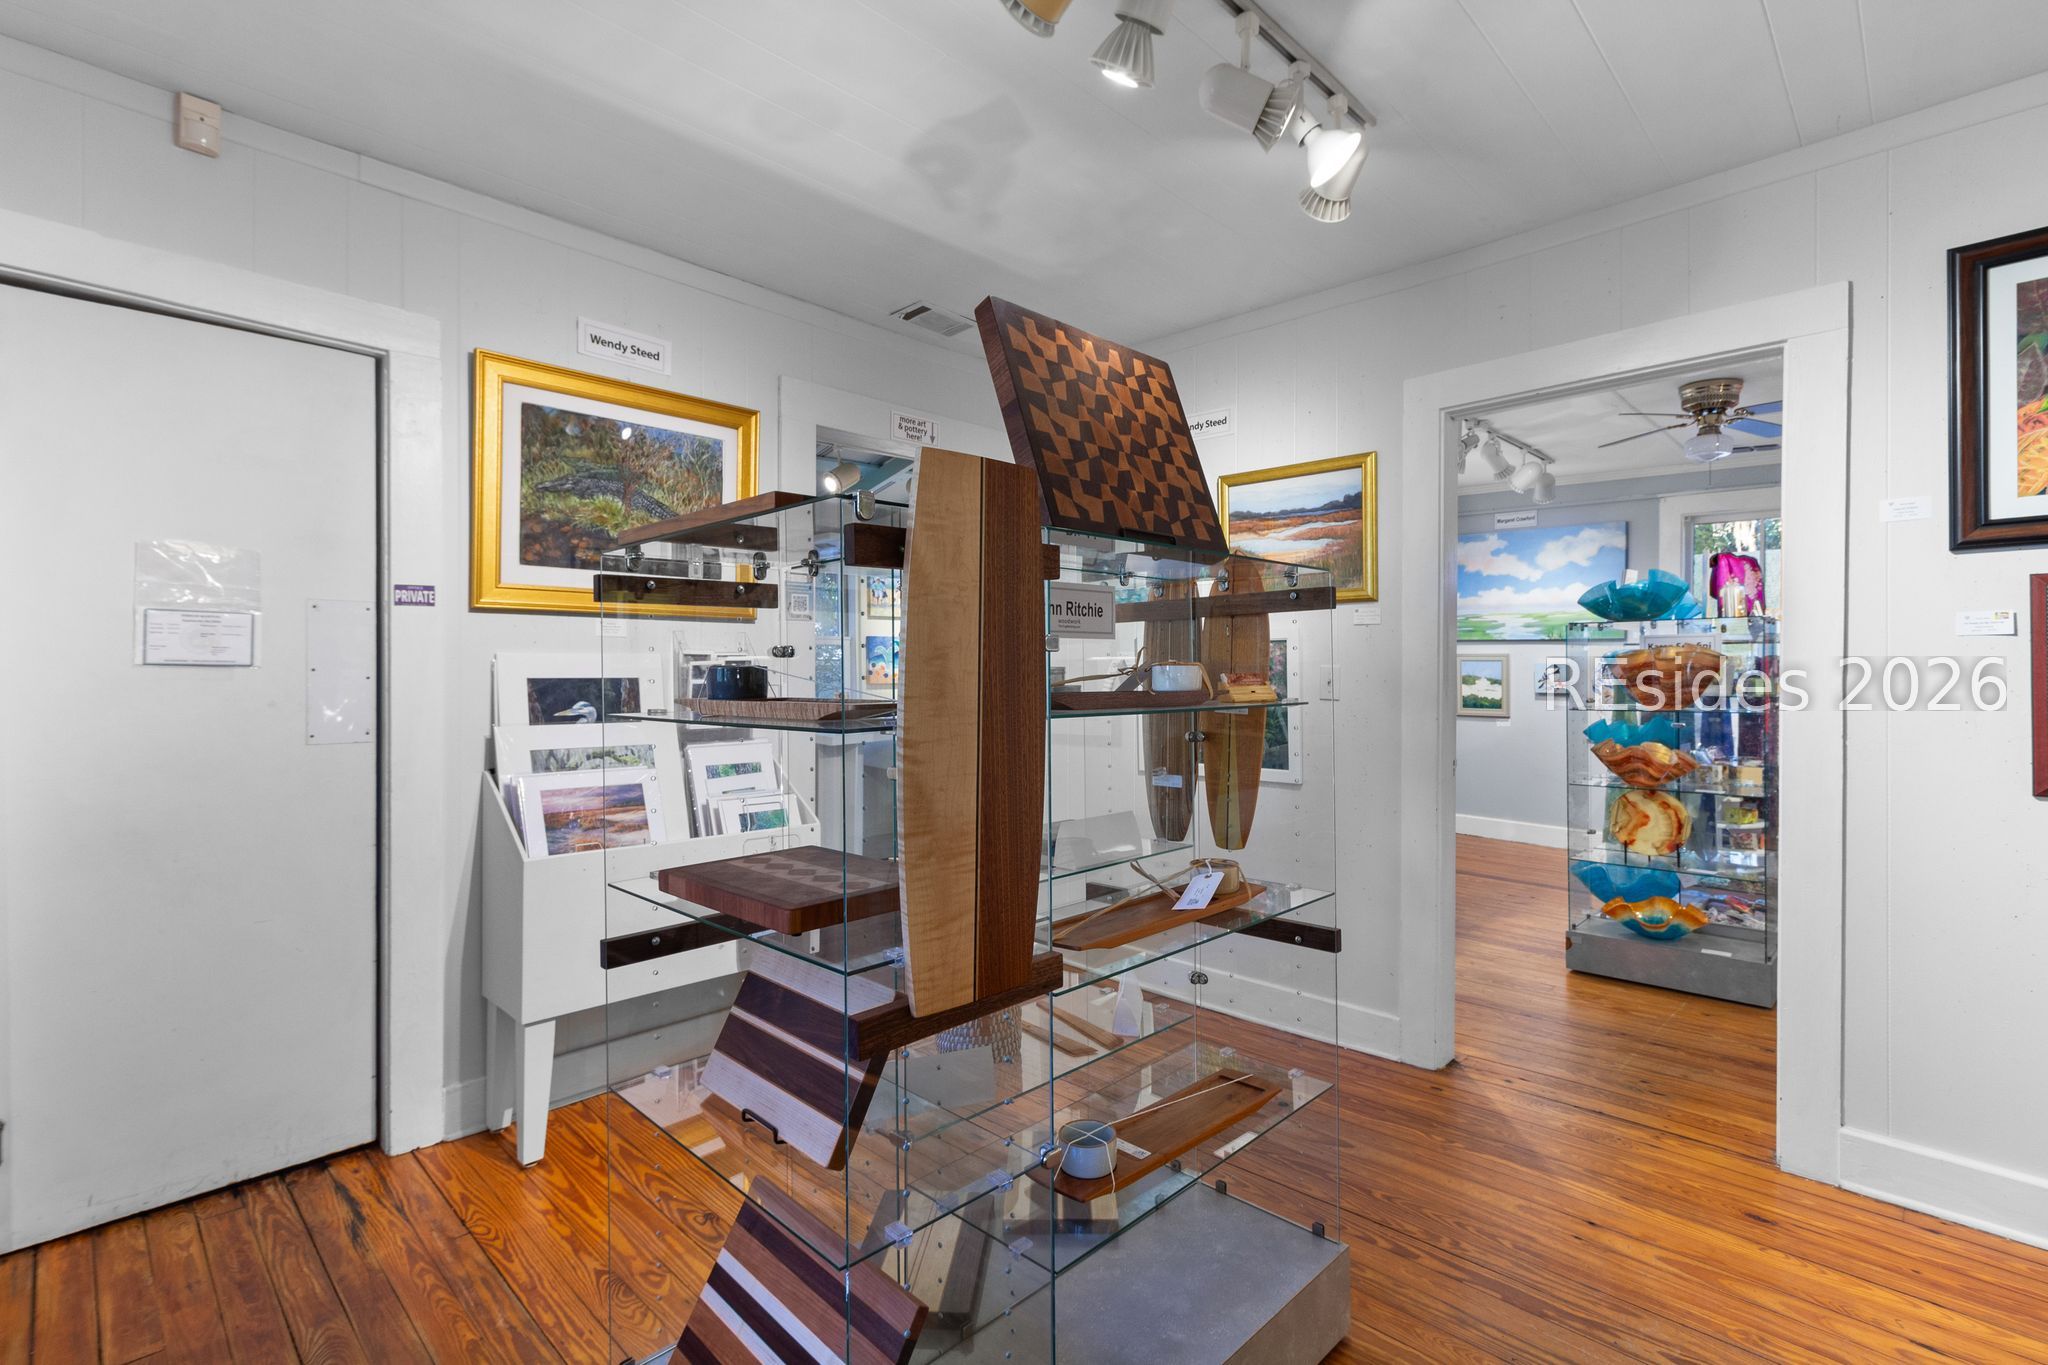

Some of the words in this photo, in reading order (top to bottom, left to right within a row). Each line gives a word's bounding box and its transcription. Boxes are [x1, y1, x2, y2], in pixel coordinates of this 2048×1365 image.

[590, 333, 628, 354] Wendy
[630, 345, 660, 361] Steed
[900, 416, 916, 425] more
[917, 420, 926, 428] art
[1205, 416, 1228, 428] Steed
[904, 425, 928, 436] pottery
[395, 590, 434, 603] PRIVATE
[1066, 601, 1104, 618] Ritchie
